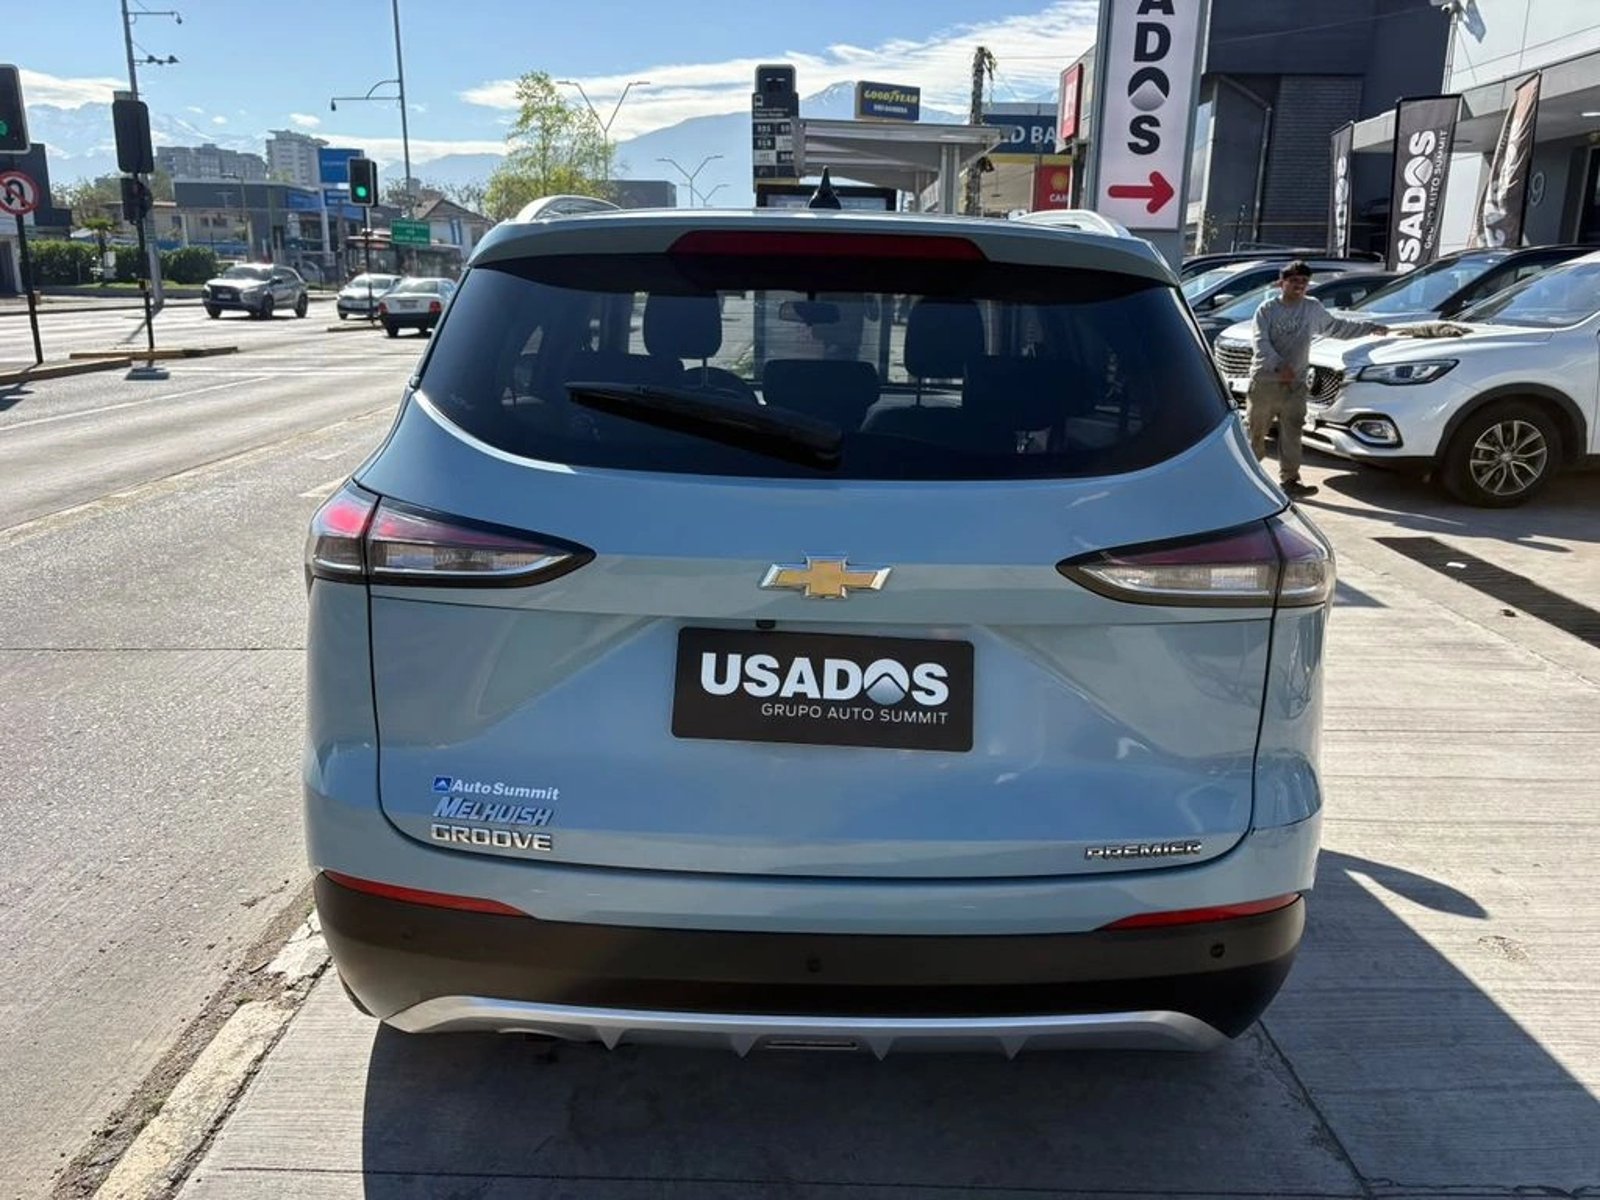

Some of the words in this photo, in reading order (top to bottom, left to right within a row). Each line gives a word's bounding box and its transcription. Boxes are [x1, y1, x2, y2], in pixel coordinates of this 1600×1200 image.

[701, 651, 950, 708] USADOS
[761, 702, 822, 719] GRUPO
[828, 706, 874, 722] AUTO
[880, 708, 948, 726] SUMMIT
[432, 796, 554, 826] MELHUISH
[431, 823, 551, 851] GROOVE
[1085, 841, 1202, 860] PREMIER
